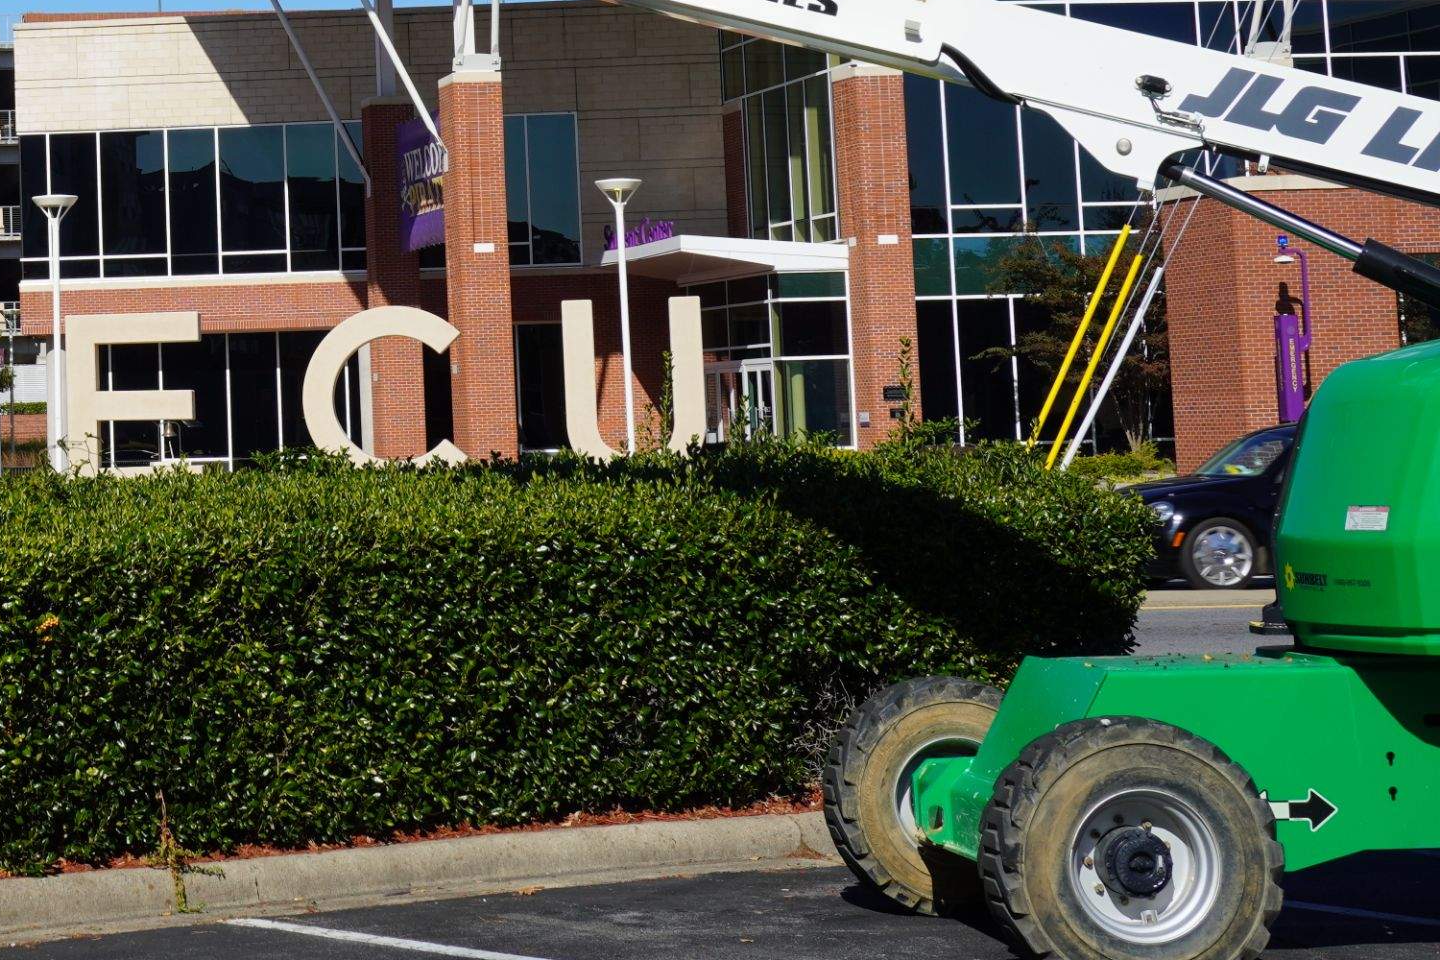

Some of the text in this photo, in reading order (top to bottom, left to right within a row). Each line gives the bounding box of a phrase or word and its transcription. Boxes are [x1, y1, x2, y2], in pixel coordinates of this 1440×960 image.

[1177, 66, 1362, 145] JLG
[65, 296, 708, 477] ECU
[1288, 338, 1298, 393] EMERGENCY
